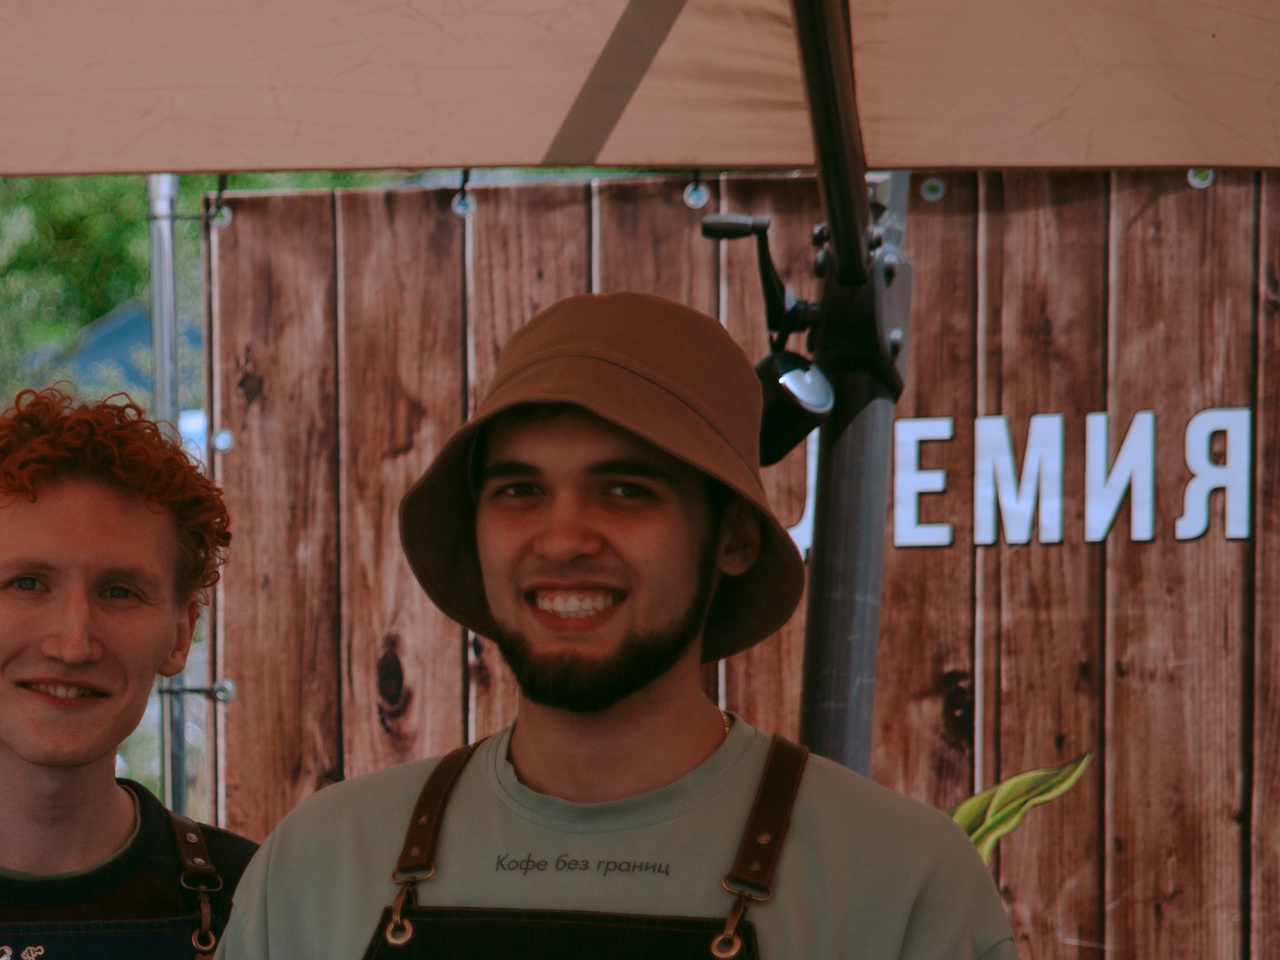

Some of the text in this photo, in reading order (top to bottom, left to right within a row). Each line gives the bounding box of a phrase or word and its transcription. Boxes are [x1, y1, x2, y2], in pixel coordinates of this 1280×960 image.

[788, 407, 1252, 562] ЕМИЯ
[495, 853, 671, 877] Кофе без границ
